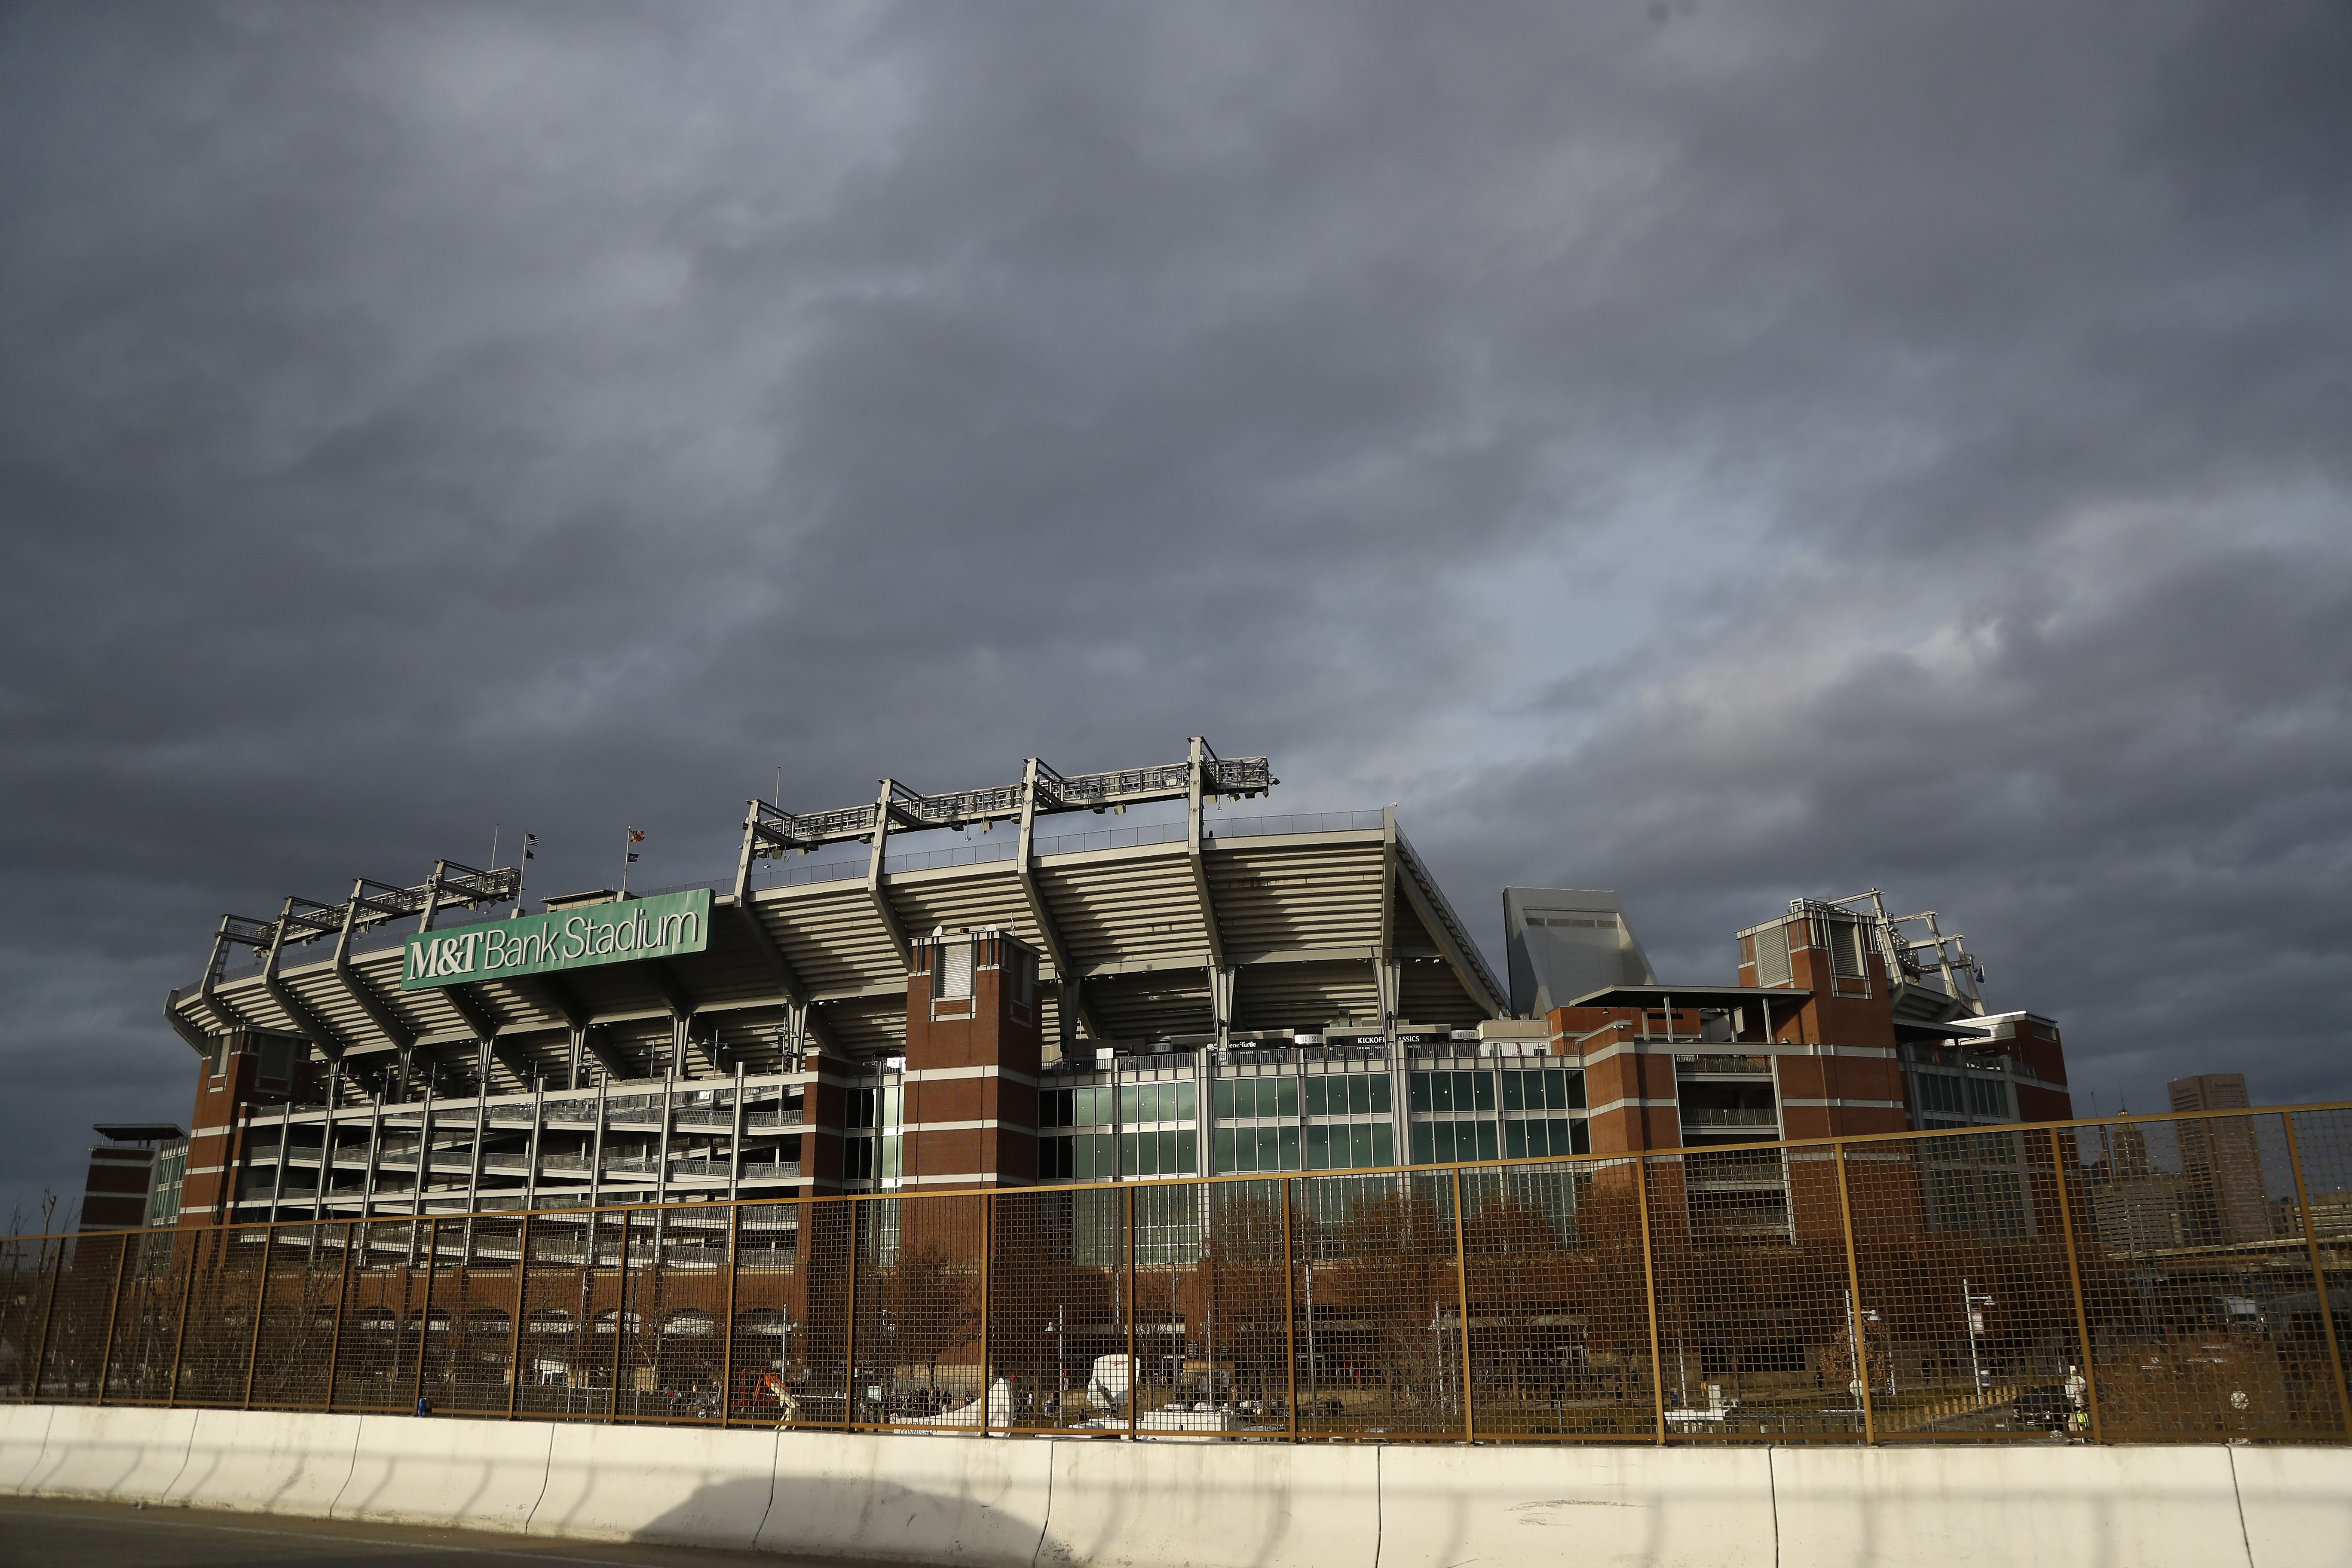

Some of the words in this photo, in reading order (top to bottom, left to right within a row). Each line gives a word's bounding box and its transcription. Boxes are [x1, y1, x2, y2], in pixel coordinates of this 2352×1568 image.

[407, 931, 484, 980] M&T
[484, 922, 559, 970] Bank
[562, 908, 699, 959] Stadium
